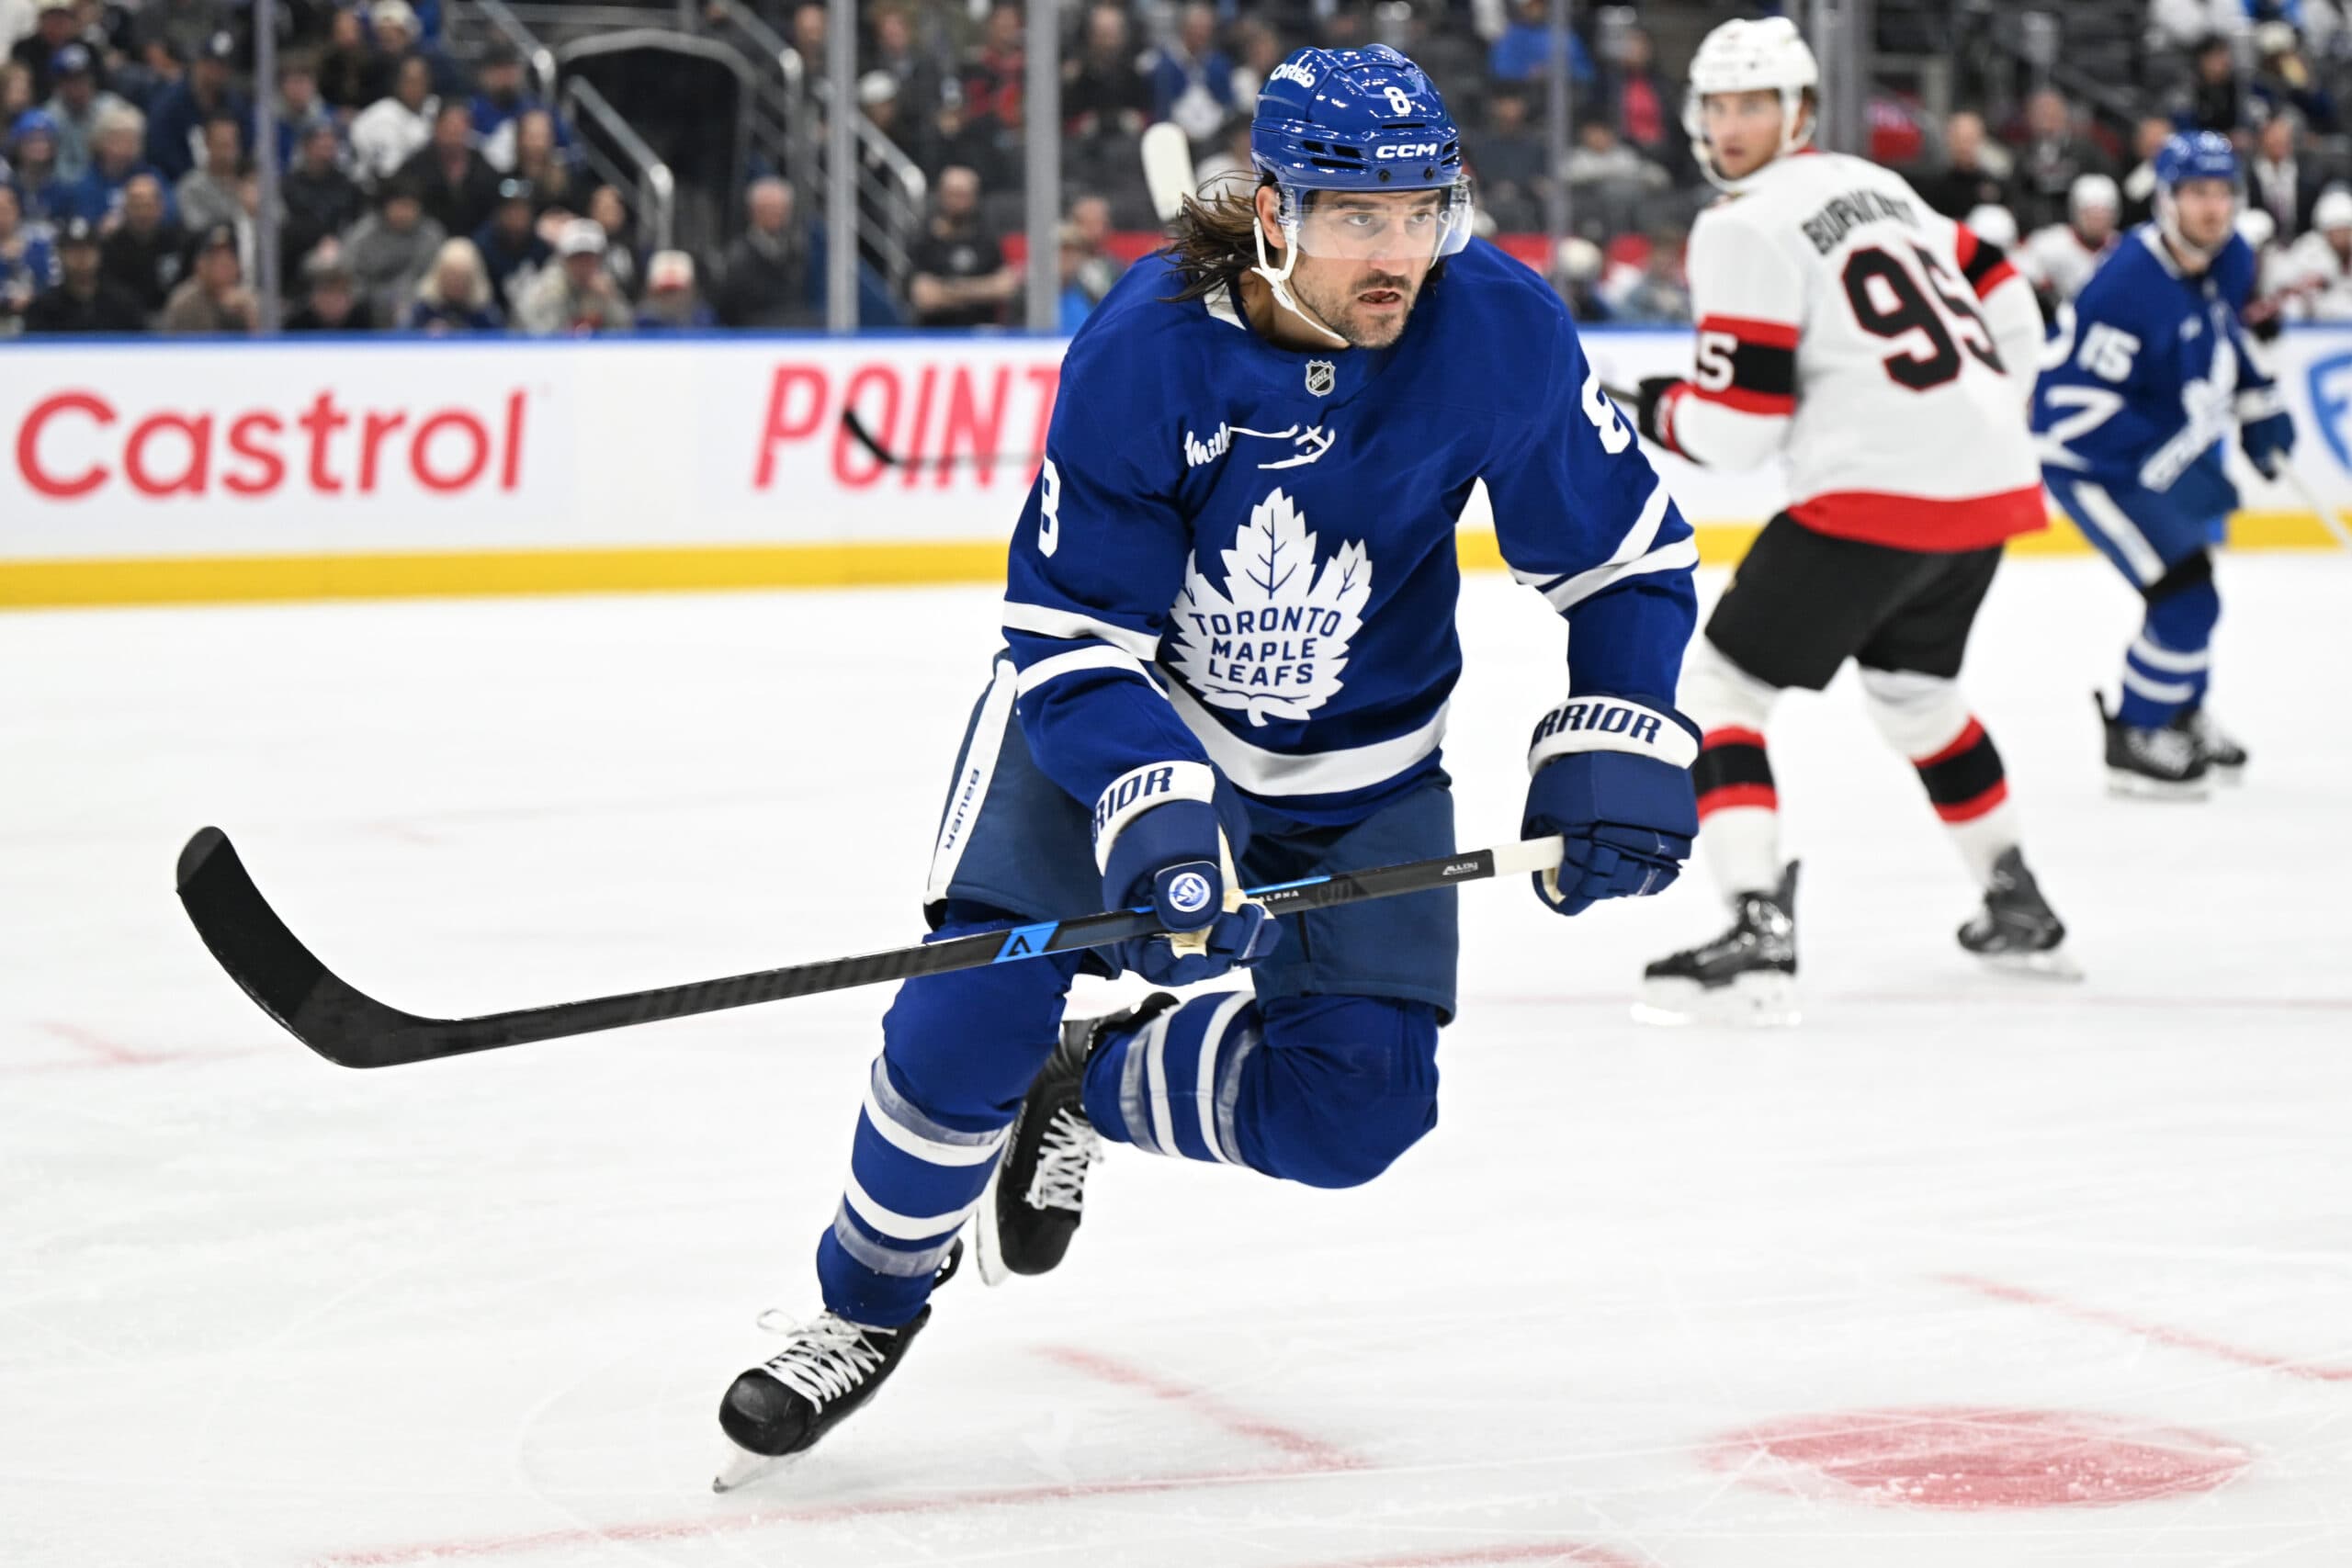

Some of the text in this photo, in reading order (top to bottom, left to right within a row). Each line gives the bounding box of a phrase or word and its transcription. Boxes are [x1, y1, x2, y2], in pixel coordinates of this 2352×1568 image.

[1383, 86, 1412, 114] 8
[1375, 142, 1438, 159] CCM
[1840, 237, 2010, 393] 95
[2076, 321, 2142, 383] 15
[1311, 368, 1329, 389] NHL
[1581, 375, 1632, 454] 8
[15, 388, 527, 502] Castrol
[1184, 422, 1231, 467] Milk
[1038, 456, 1061, 558] 8
[1187, 605, 1342, 637] TORONTO
[1208, 658, 1315, 687] LEAFS
[1211, 637, 1318, 663] MAPLE
[1091, 766, 1174, 843] RIOR
